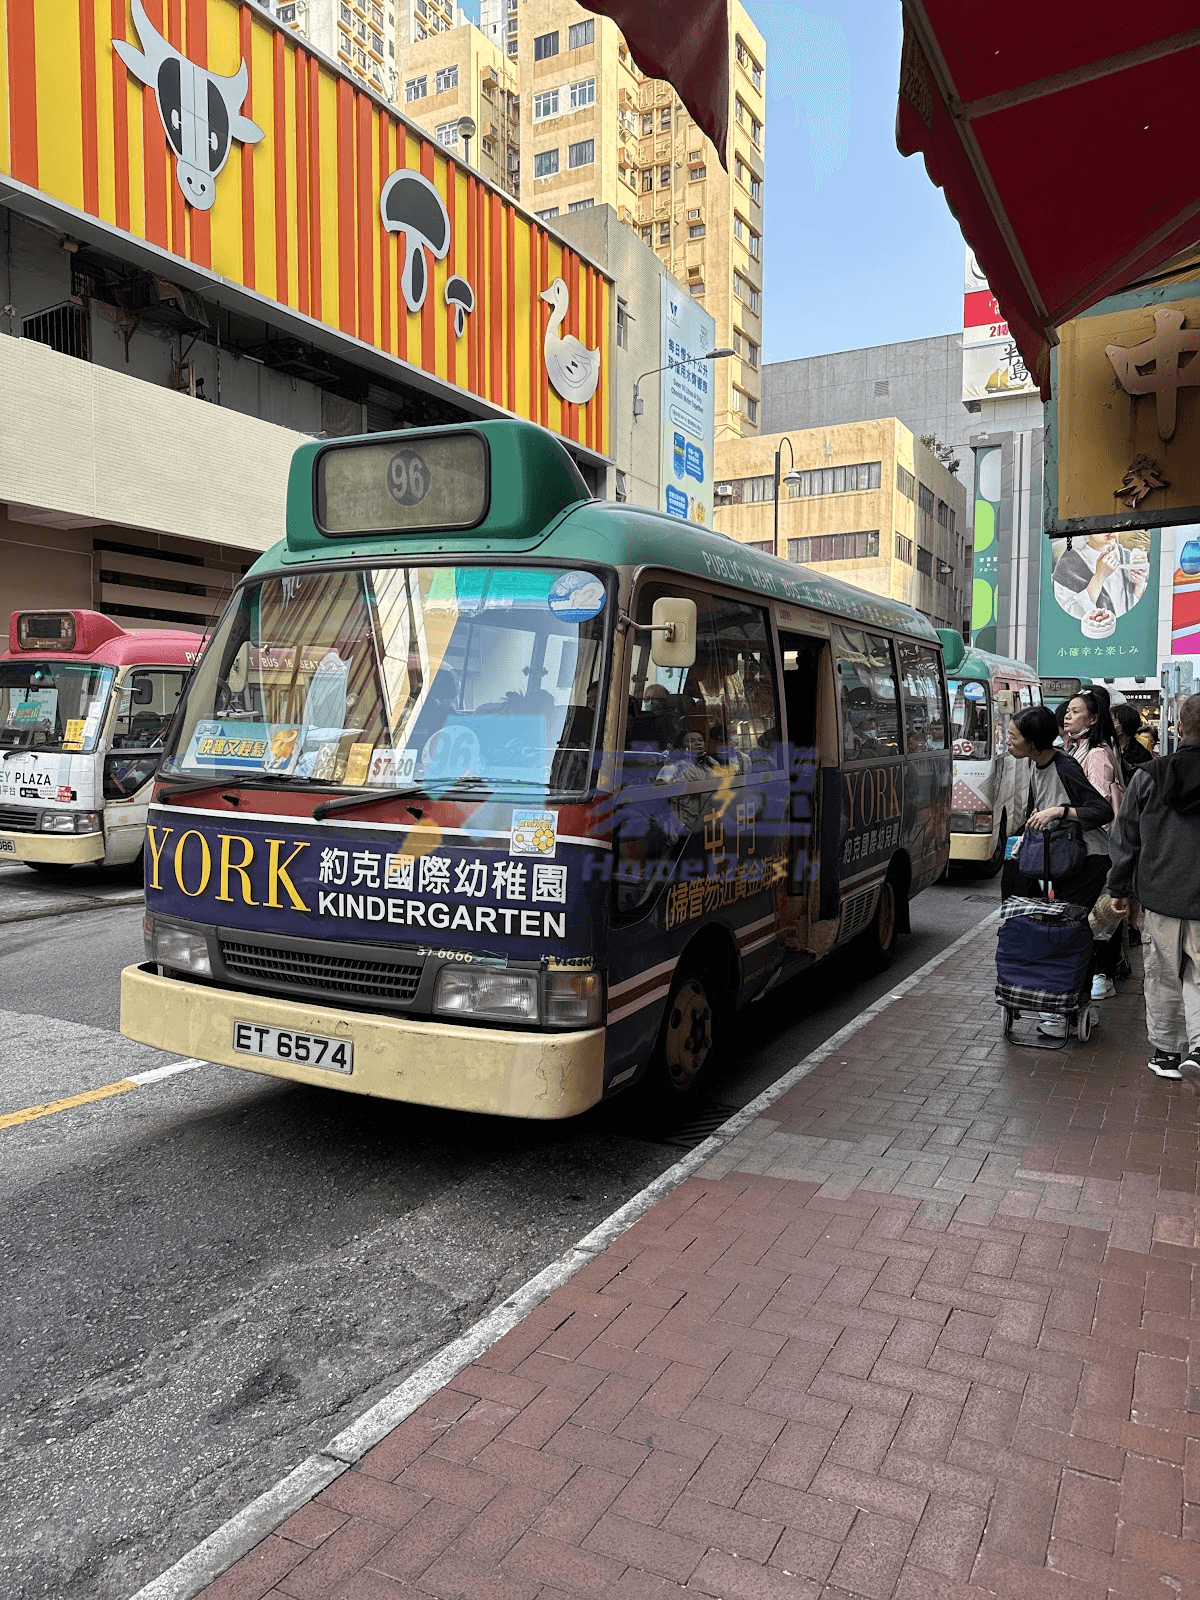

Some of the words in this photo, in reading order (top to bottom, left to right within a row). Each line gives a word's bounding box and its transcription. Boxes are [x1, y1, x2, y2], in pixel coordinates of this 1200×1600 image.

[999, 343, 1029, 382] 半島
[1105, 308, 1200, 441] 中
[391, 457, 425, 499] 96
[701, 550, 744, 582] PUBLIC
[748, 566, 777, 593] LIGHT
[781, 577, 801, 600] BUS
[815, 588, 841, 610] SEATS
[262, 656, 279, 668] BUS
[300, 658, 326, 671] SEATS
[1057, 644, 1139, 657] 小確幸な楽しみ
[1050, 680, 1062, 691] 96
[372, 757, 414, 778] $7.20
[953, 740, 973, 755] 96
[15, 772, 52, 786] PLAZA
[844, 765, 901, 832] YORK
[703, 801, 756, 865] 屯門
[147, 825, 311, 912] YORK
[318, 847, 568, 904] 約克國際幼稚園
[318, 891, 566, 938] KINDERGARTEN
[438, 948, 473, 963] 6666
[236, 1024, 270, 1053] ET
[277, 1033, 347, 1069] 6574
